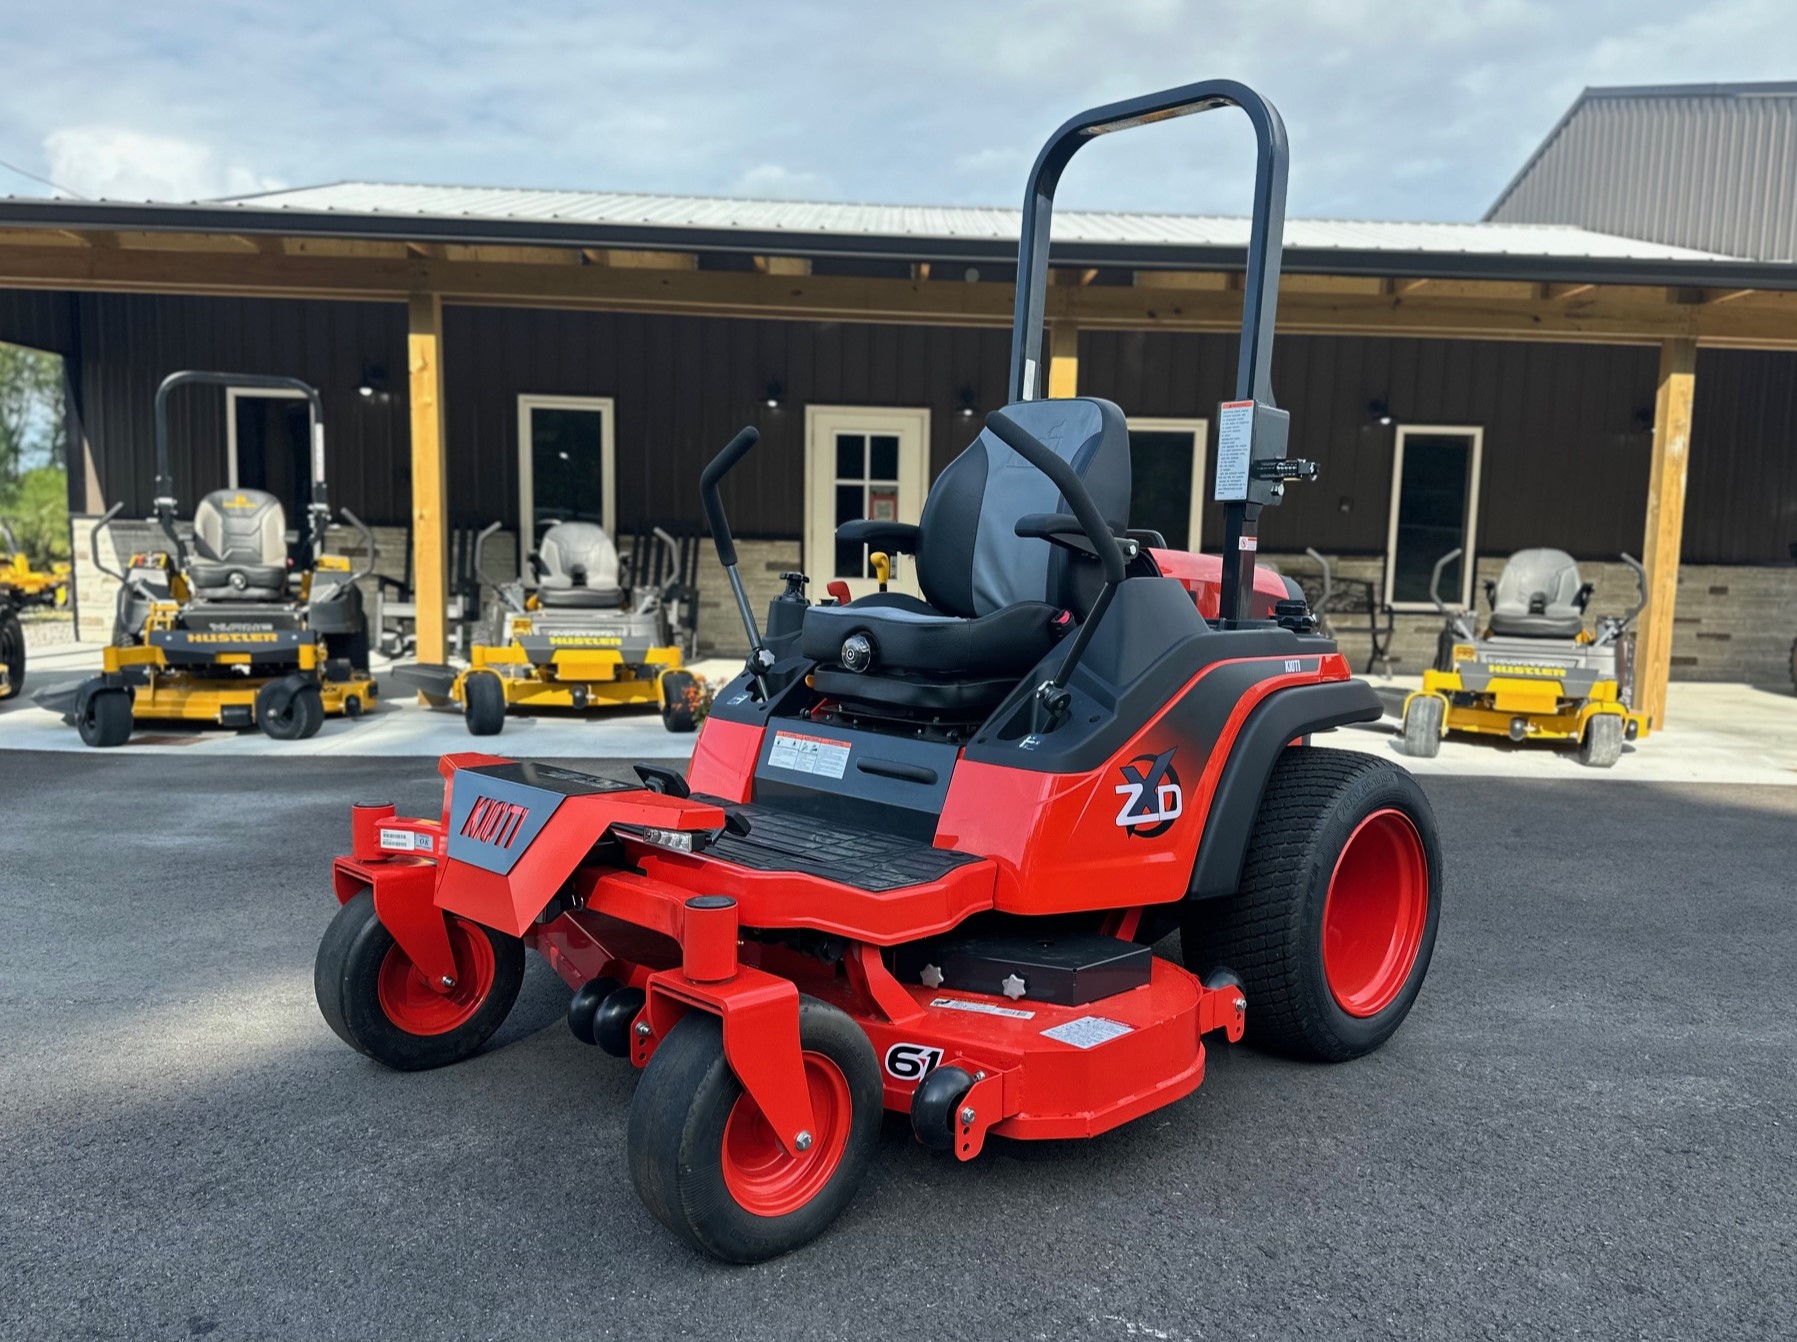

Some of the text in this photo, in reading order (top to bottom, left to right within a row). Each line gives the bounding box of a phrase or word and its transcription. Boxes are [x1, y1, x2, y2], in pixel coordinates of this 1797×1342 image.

[187, 633, 278, 643] HUSTLER
[549, 636, 622, 645] HUSTLER
[1284, 659, 1301, 673] KIOTI
[1488, 664, 1567, 677] HUSTLER
[459, 795, 530, 849] KIOTI
[886, 1044, 943, 1080] 61
